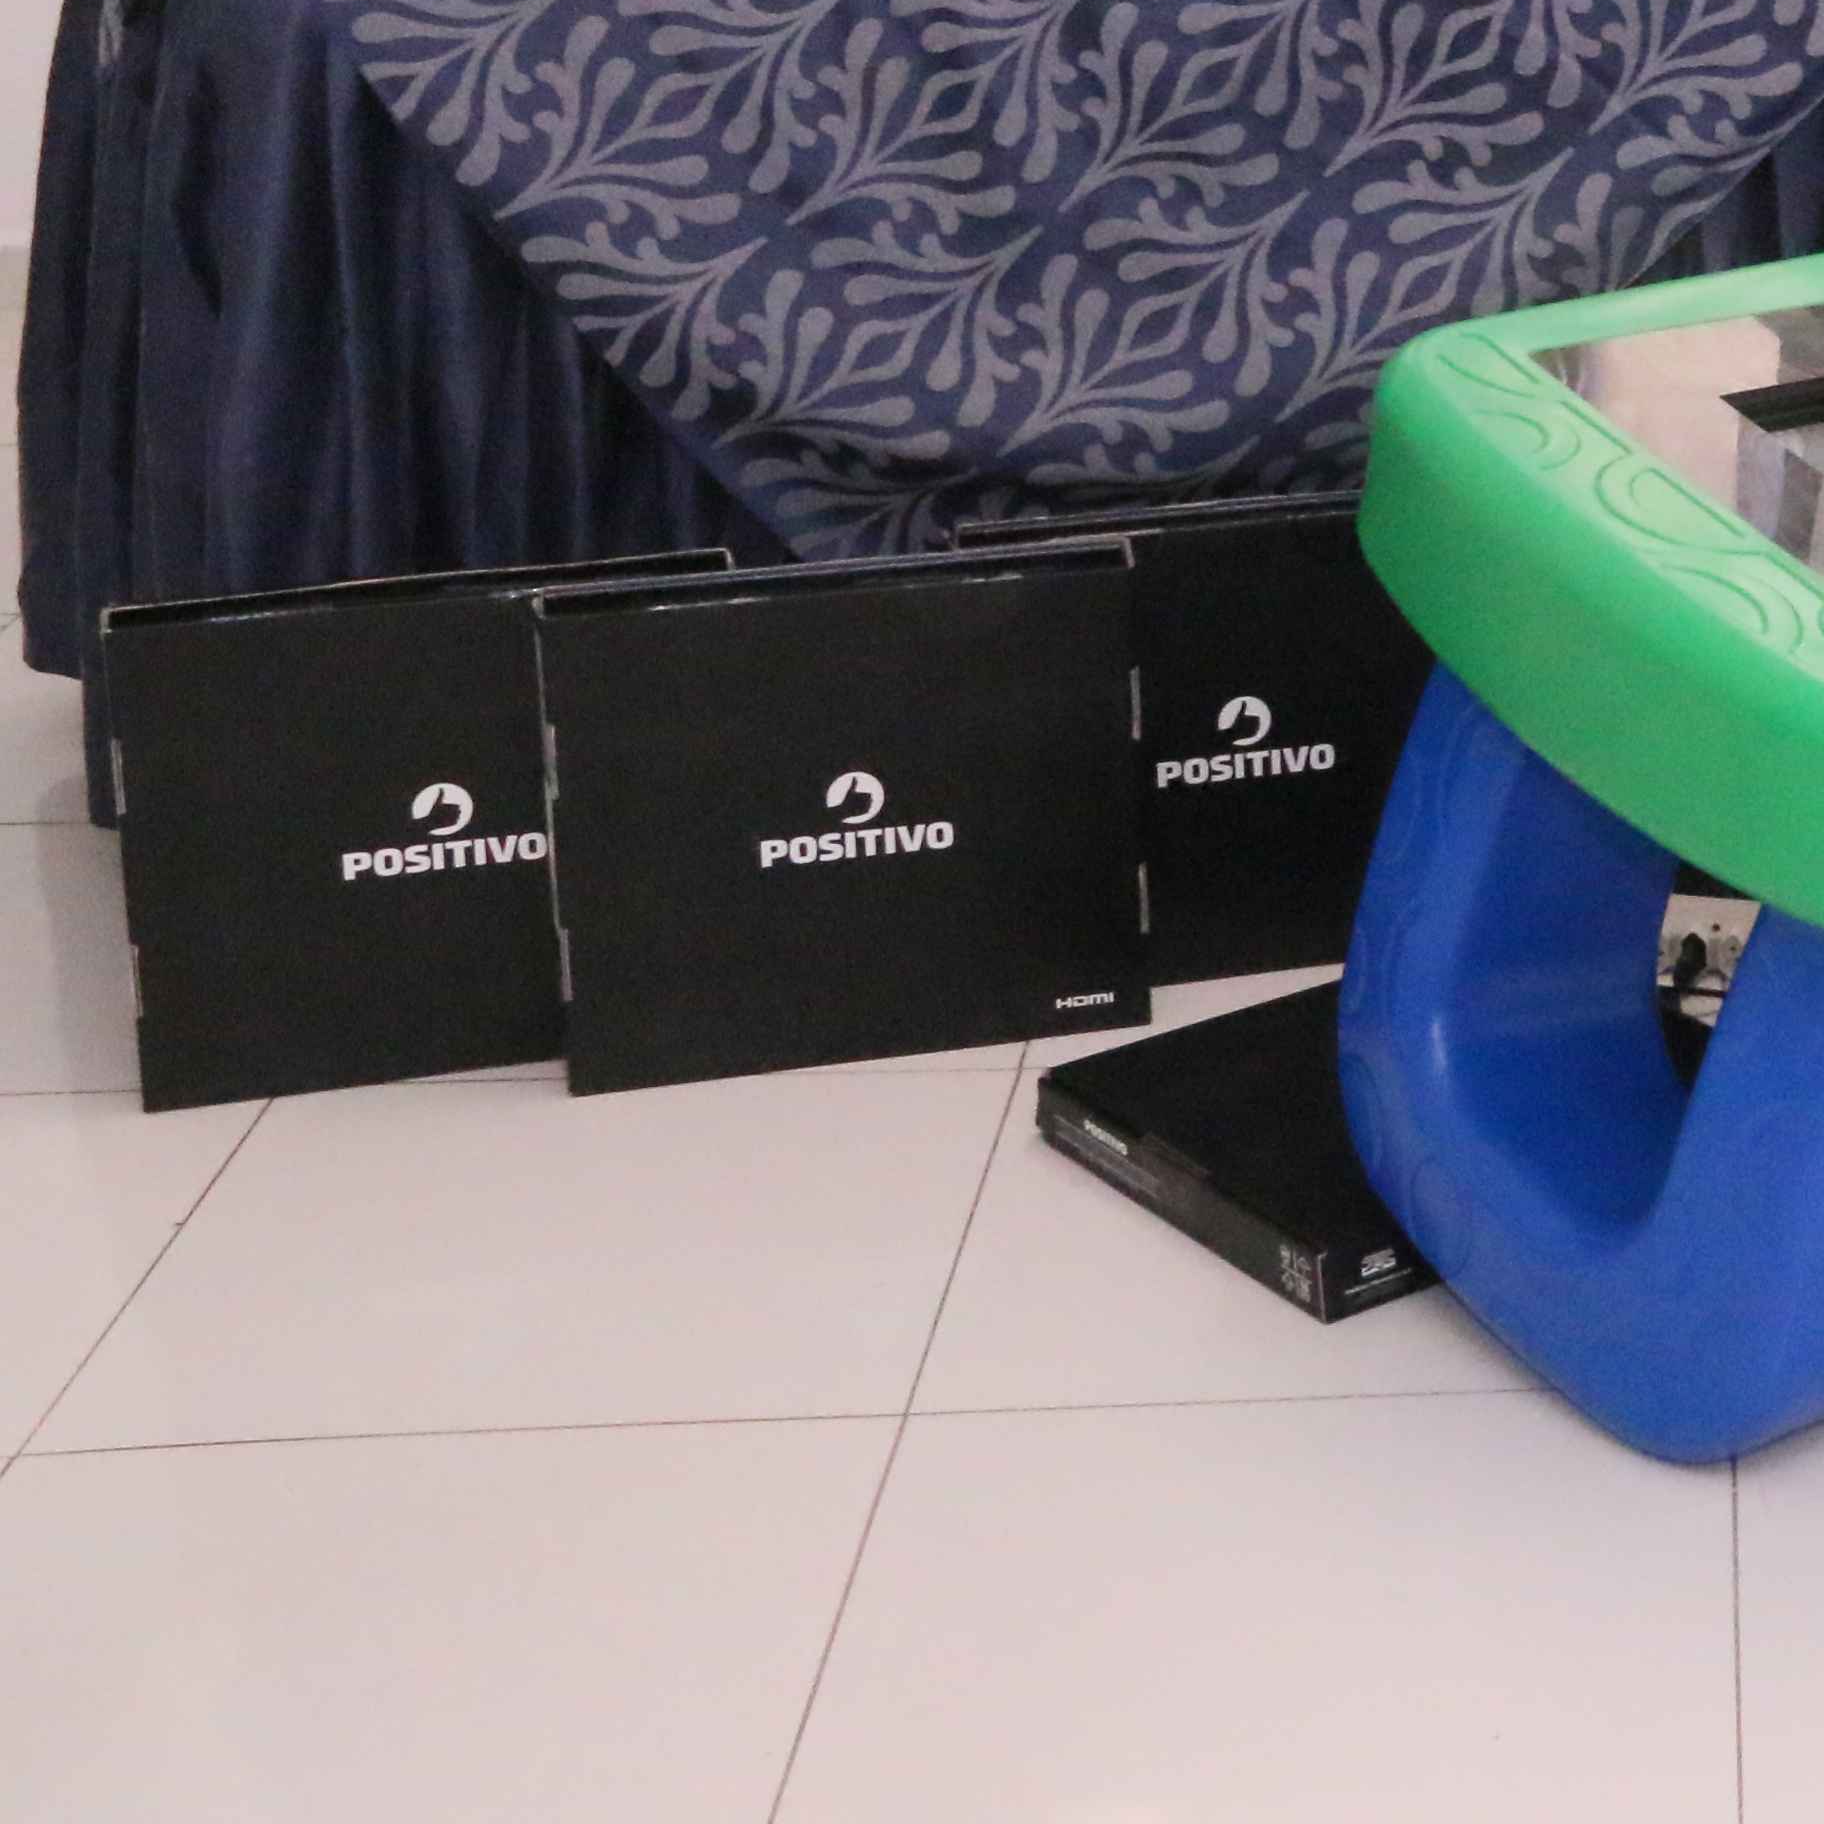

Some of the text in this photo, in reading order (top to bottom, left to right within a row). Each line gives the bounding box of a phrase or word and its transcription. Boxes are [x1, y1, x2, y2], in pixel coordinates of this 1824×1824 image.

[1156, 743, 1336, 789] POSITIVO
[342, 832, 548, 881] POSITIVO
[760, 821, 954, 869] POSITIVO
[1054, 991, 1115, 1009] HDMI
